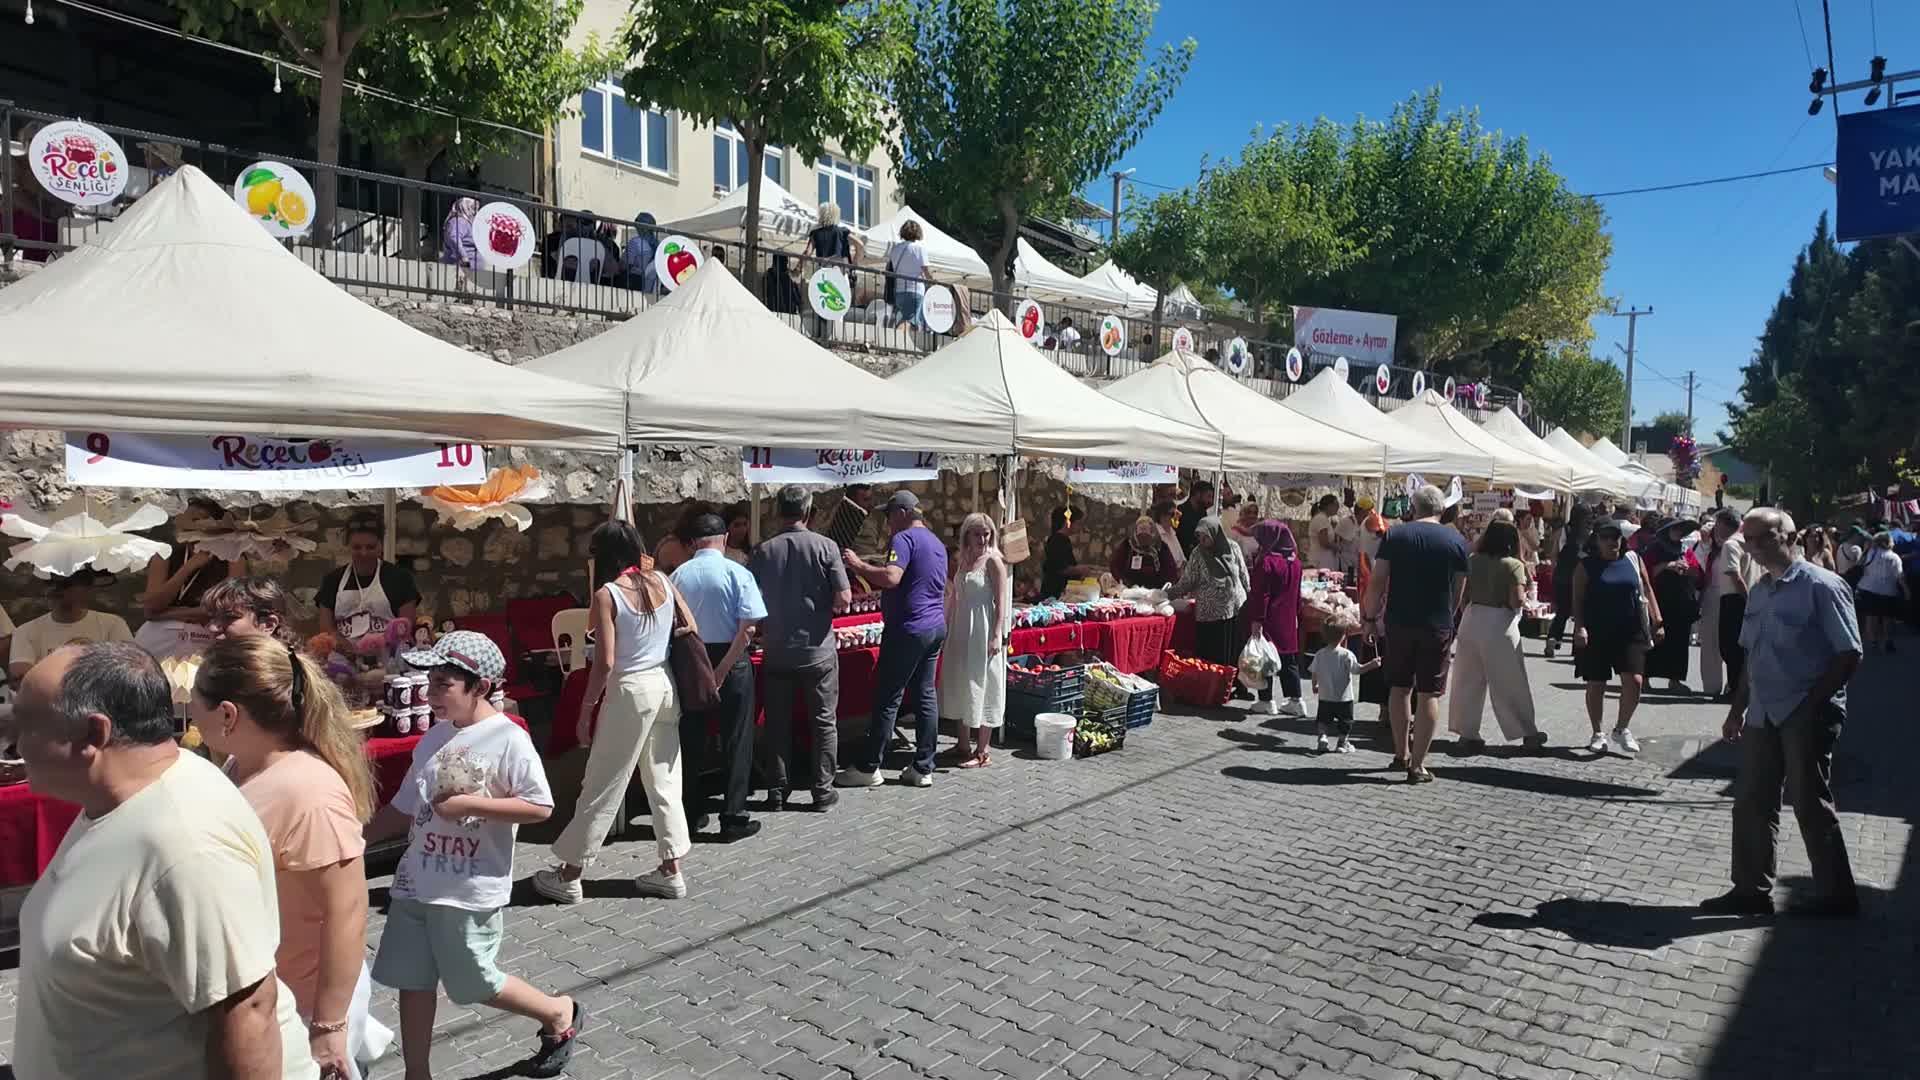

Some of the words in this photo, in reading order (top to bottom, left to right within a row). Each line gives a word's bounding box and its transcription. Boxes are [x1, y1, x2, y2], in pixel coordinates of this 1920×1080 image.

[43, 153, 111, 181] Reçel
[1312, 327, 1354, 346] Gözleme
[1362, 332, 1388, 352] Ayran
[86, 433, 111, 465] 9
[212, 435, 308, 470] Reçel
[435, 443, 473, 467] 10
[750, 447, 773, 469] 11
[424, 831, 480, 858] STAY
[419, 850, 481, 877] TRUE
